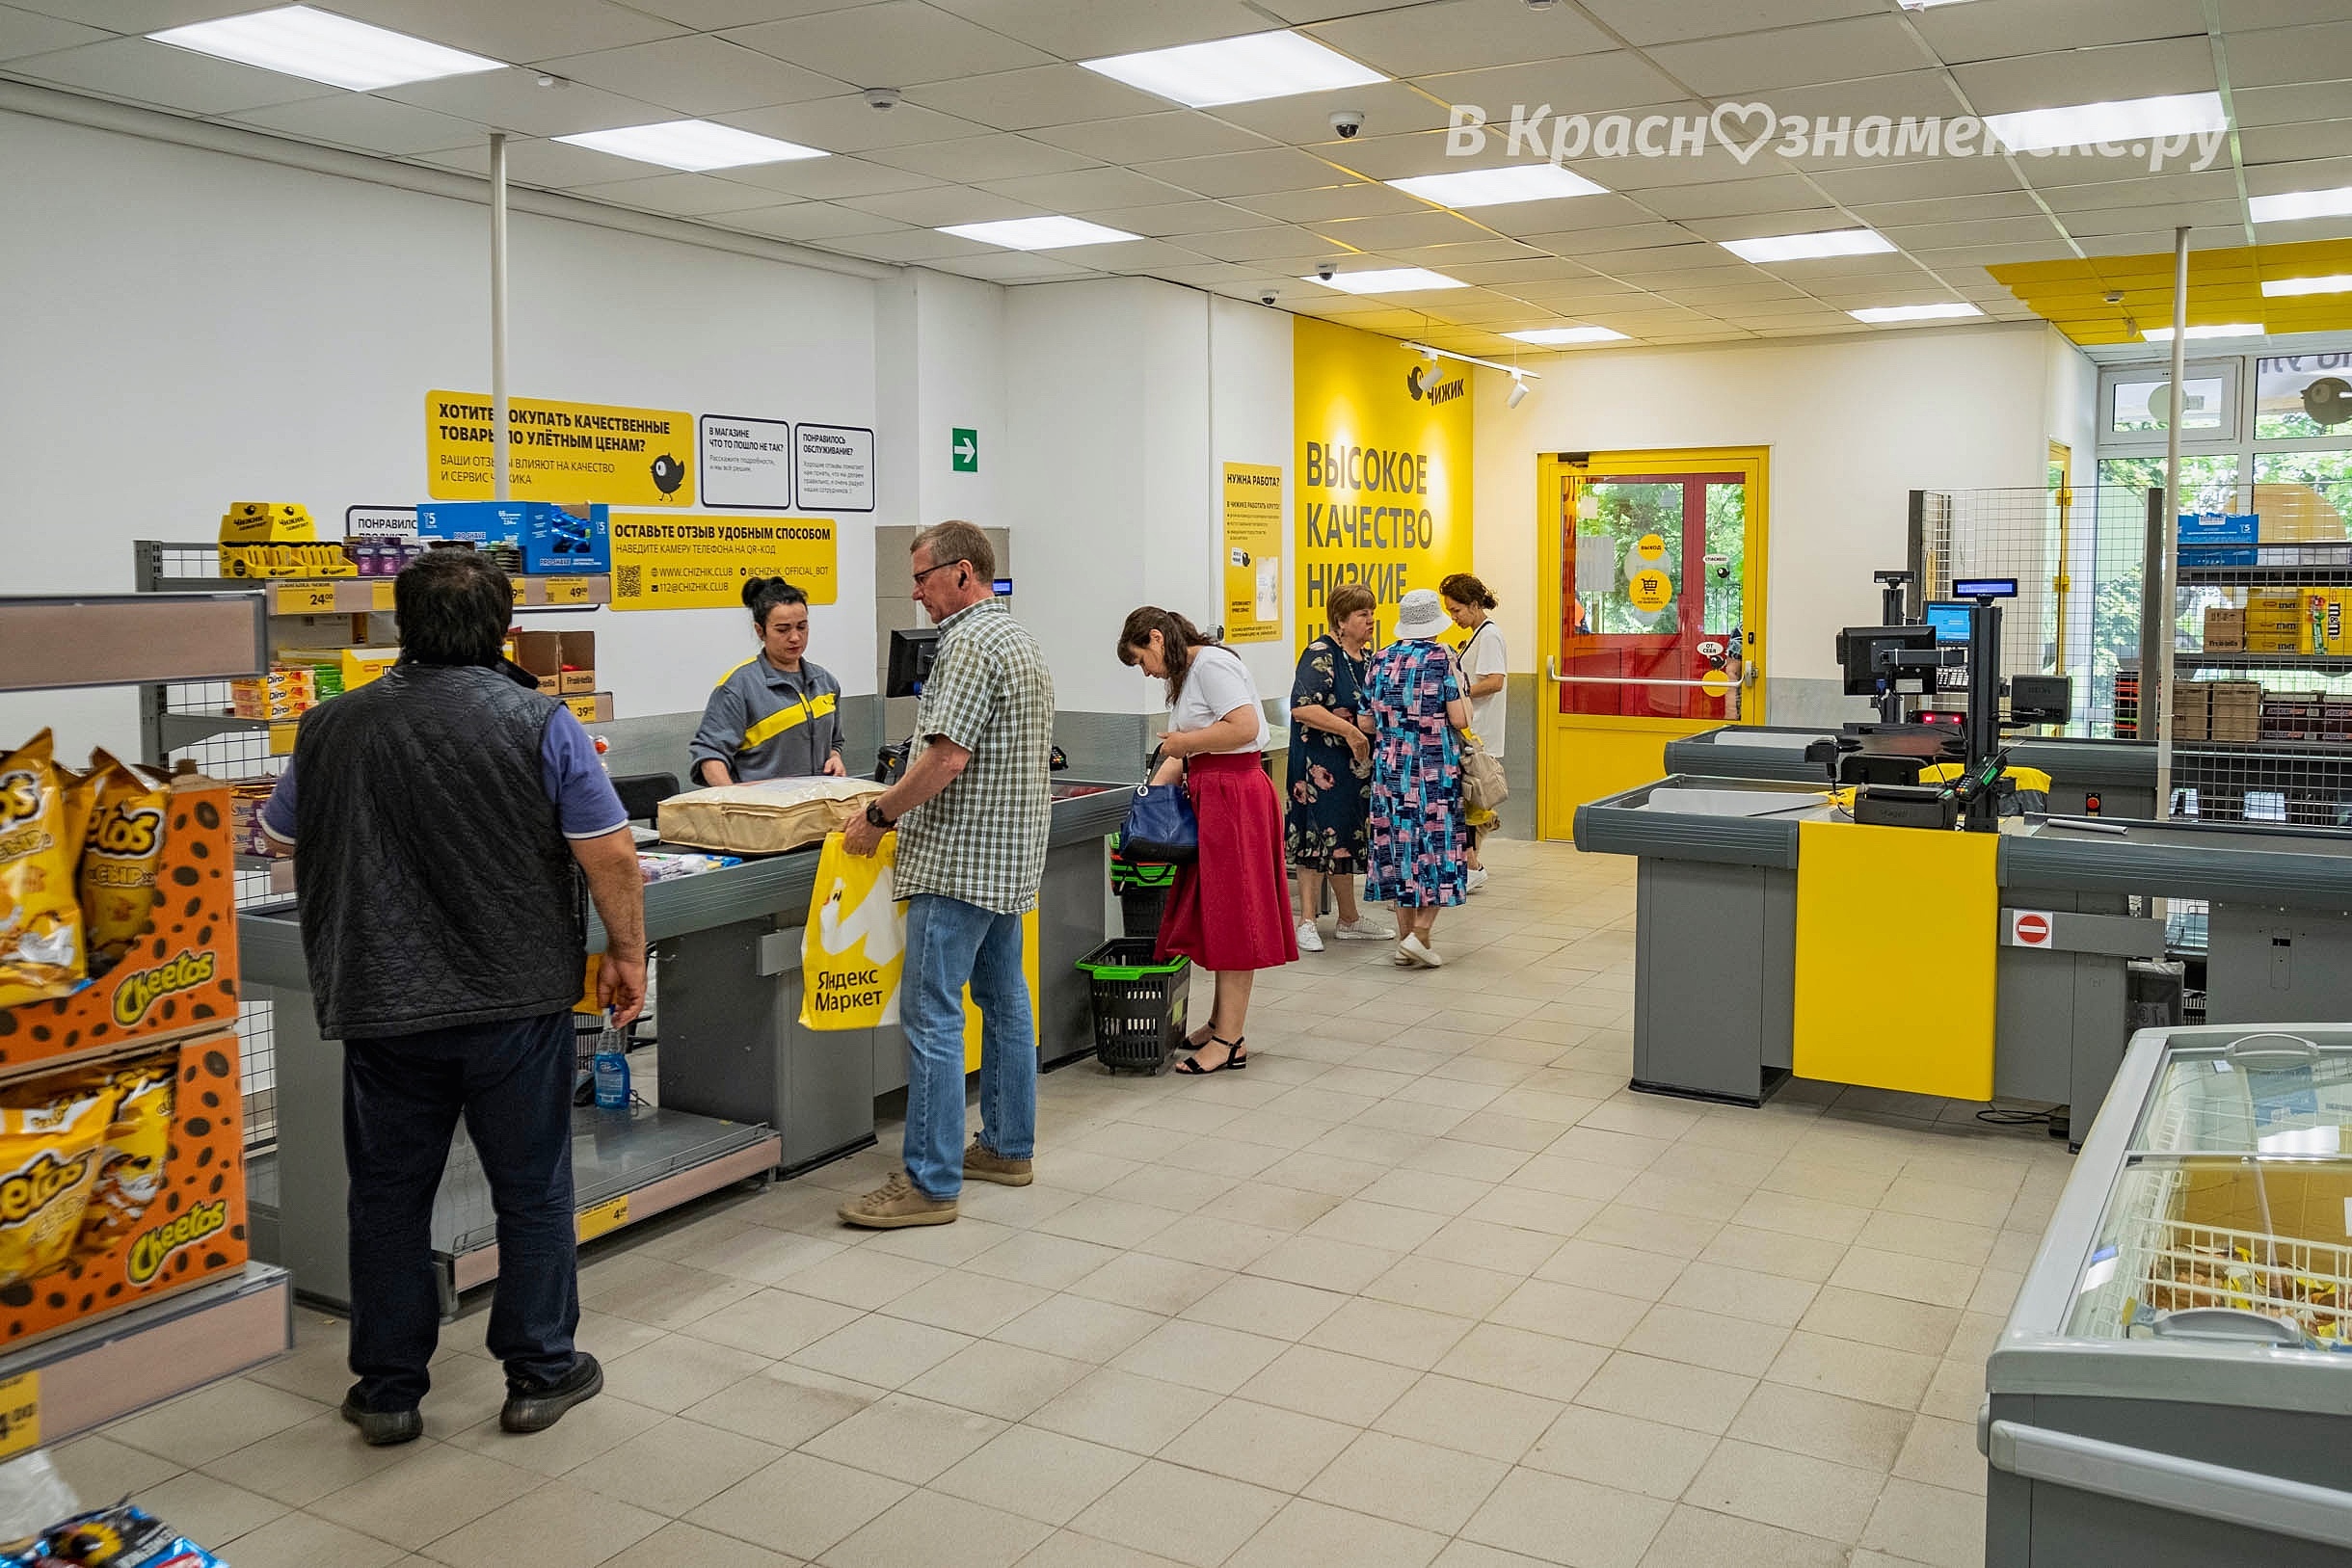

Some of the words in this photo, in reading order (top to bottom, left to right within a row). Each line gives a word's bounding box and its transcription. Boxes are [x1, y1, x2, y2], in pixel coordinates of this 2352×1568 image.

[440, 403, 494, 420] ХОТИТЕ
[509, 409, 571, 427] ОКУПАТЬ
[575, 414, 670, 434] КАЧЕСТВЕННЫЕ
[715, 428, 749, 438] МАГАЗИНЕ
[803, 434, 845, 444] ПОНРАВИЛОСЬ
[526, 430, 592, 449] УЛЁТНЫМ
[596, 436, 646, 452] ЦЕНАМ?
[709, 439, 723, 447] ЧТО
[724, 439, 733, 449] ТО
[734, 440, 758, 451] ПОШЛО
[760, 442, 767, 451] НЕ
[769, 443, 783, 452] ТАК?
[803, 444, 853, 455] ОБСЛУЖИВАНИЕ?
[441, 455, 470, 466] ВАШИ
[516, 459, 554, 470] ВЛИЯЮТ
[557, 462, 569, 470] НА
[571, 463, 615, 473] КАЧЕСТВО
[1307, 441, 1427, 494] ВЫСОКОЕ
[441, 471, 448, 481] И
[451, 471, 488, 482] СЕРВИС
[1227, 474, 1252, 485] НУЖНА
[1253, 476, 1280, 486] РАБОТА?
[359, 518, 416, 529] ПОНРАВИЛС
[1307, 502, 1432, 549] КАЧЕСТВО
[615, 524, 675, 538] ОСТАВЬТЕ
[678, 525, 715, 538] ОТЗЫВ
[718, 527, 773, 541] УДОБНЫМ
[776, 528, 830, 540] СПОСОБОМ
[616, 545, 658, 554] НАВЕДИТЕ
[660, 545, 690, 553] КАМЕРУ
[693, 545, 734, 554] ТЕЛЕФОНА
[747, 545, 776, 555] QR-КОД
[659, 568, 733, 576] WWW.CHIZHIK.CLUB
[659, 583, 729, 592] 112@CHIZHIK.CLUB
[267, 676, 284, 684] Dirol
[270, 690, 286, 700] Dirol
[817, 970, 879, 991] Яндекс
[115, 950, 214, 1024] Cheetos
[815, 991, 883, 1013] Маркет
[129, 1201, 227, 1284] Cheetos
